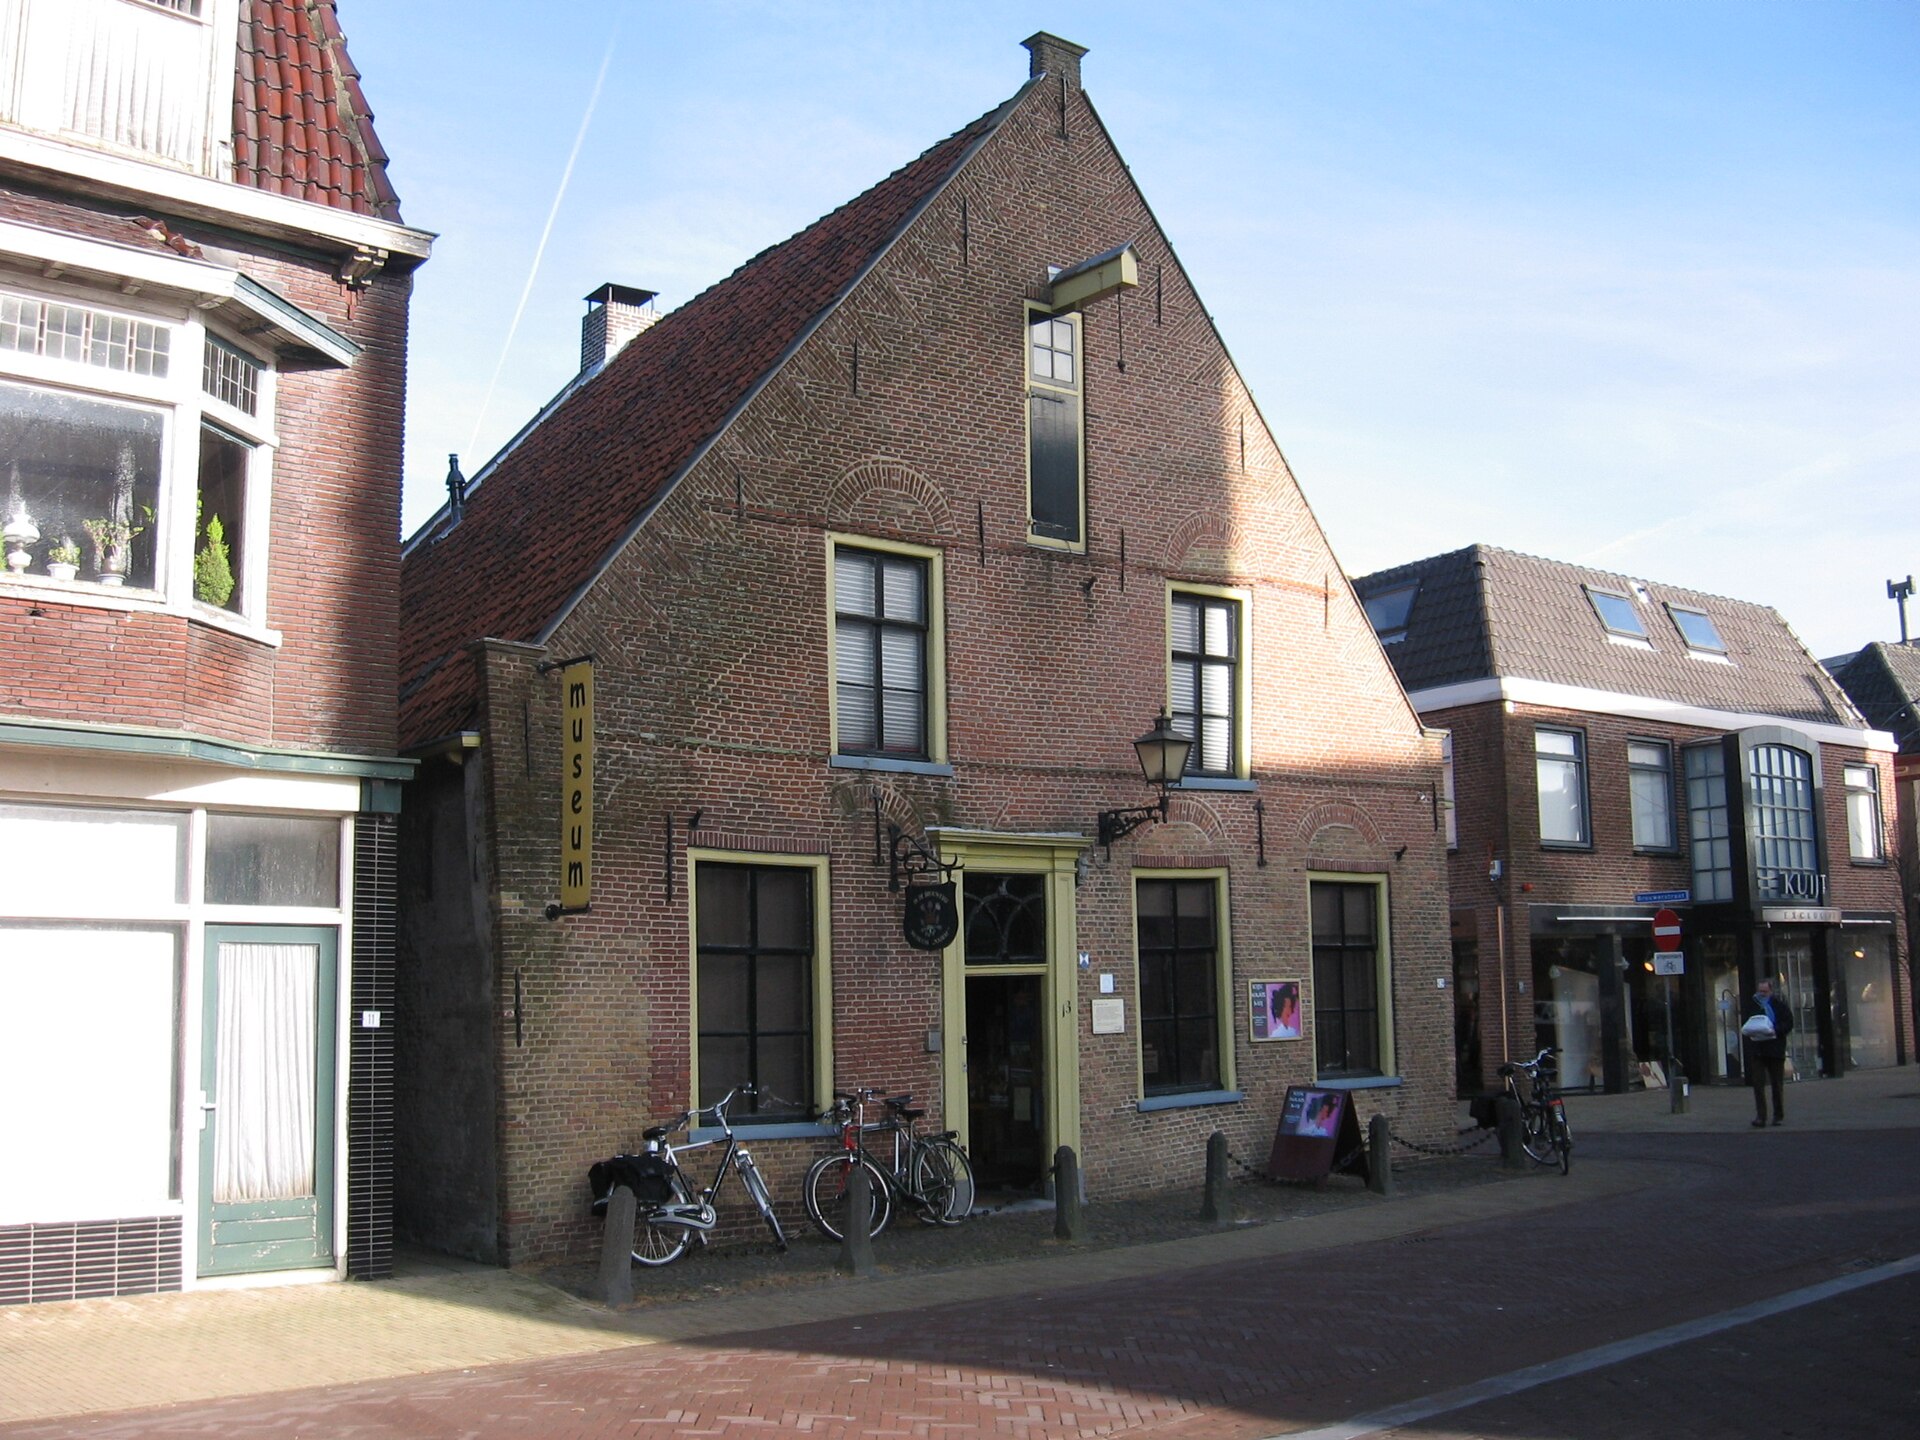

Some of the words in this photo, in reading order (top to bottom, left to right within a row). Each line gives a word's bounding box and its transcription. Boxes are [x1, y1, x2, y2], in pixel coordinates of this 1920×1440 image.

[568, 681, 586, 888] museum
[1780, 871, 1827, 899] KUIJT
[368, 1013, 375, 1025] 11
[1062, 1000, 1071, 1018] 13
